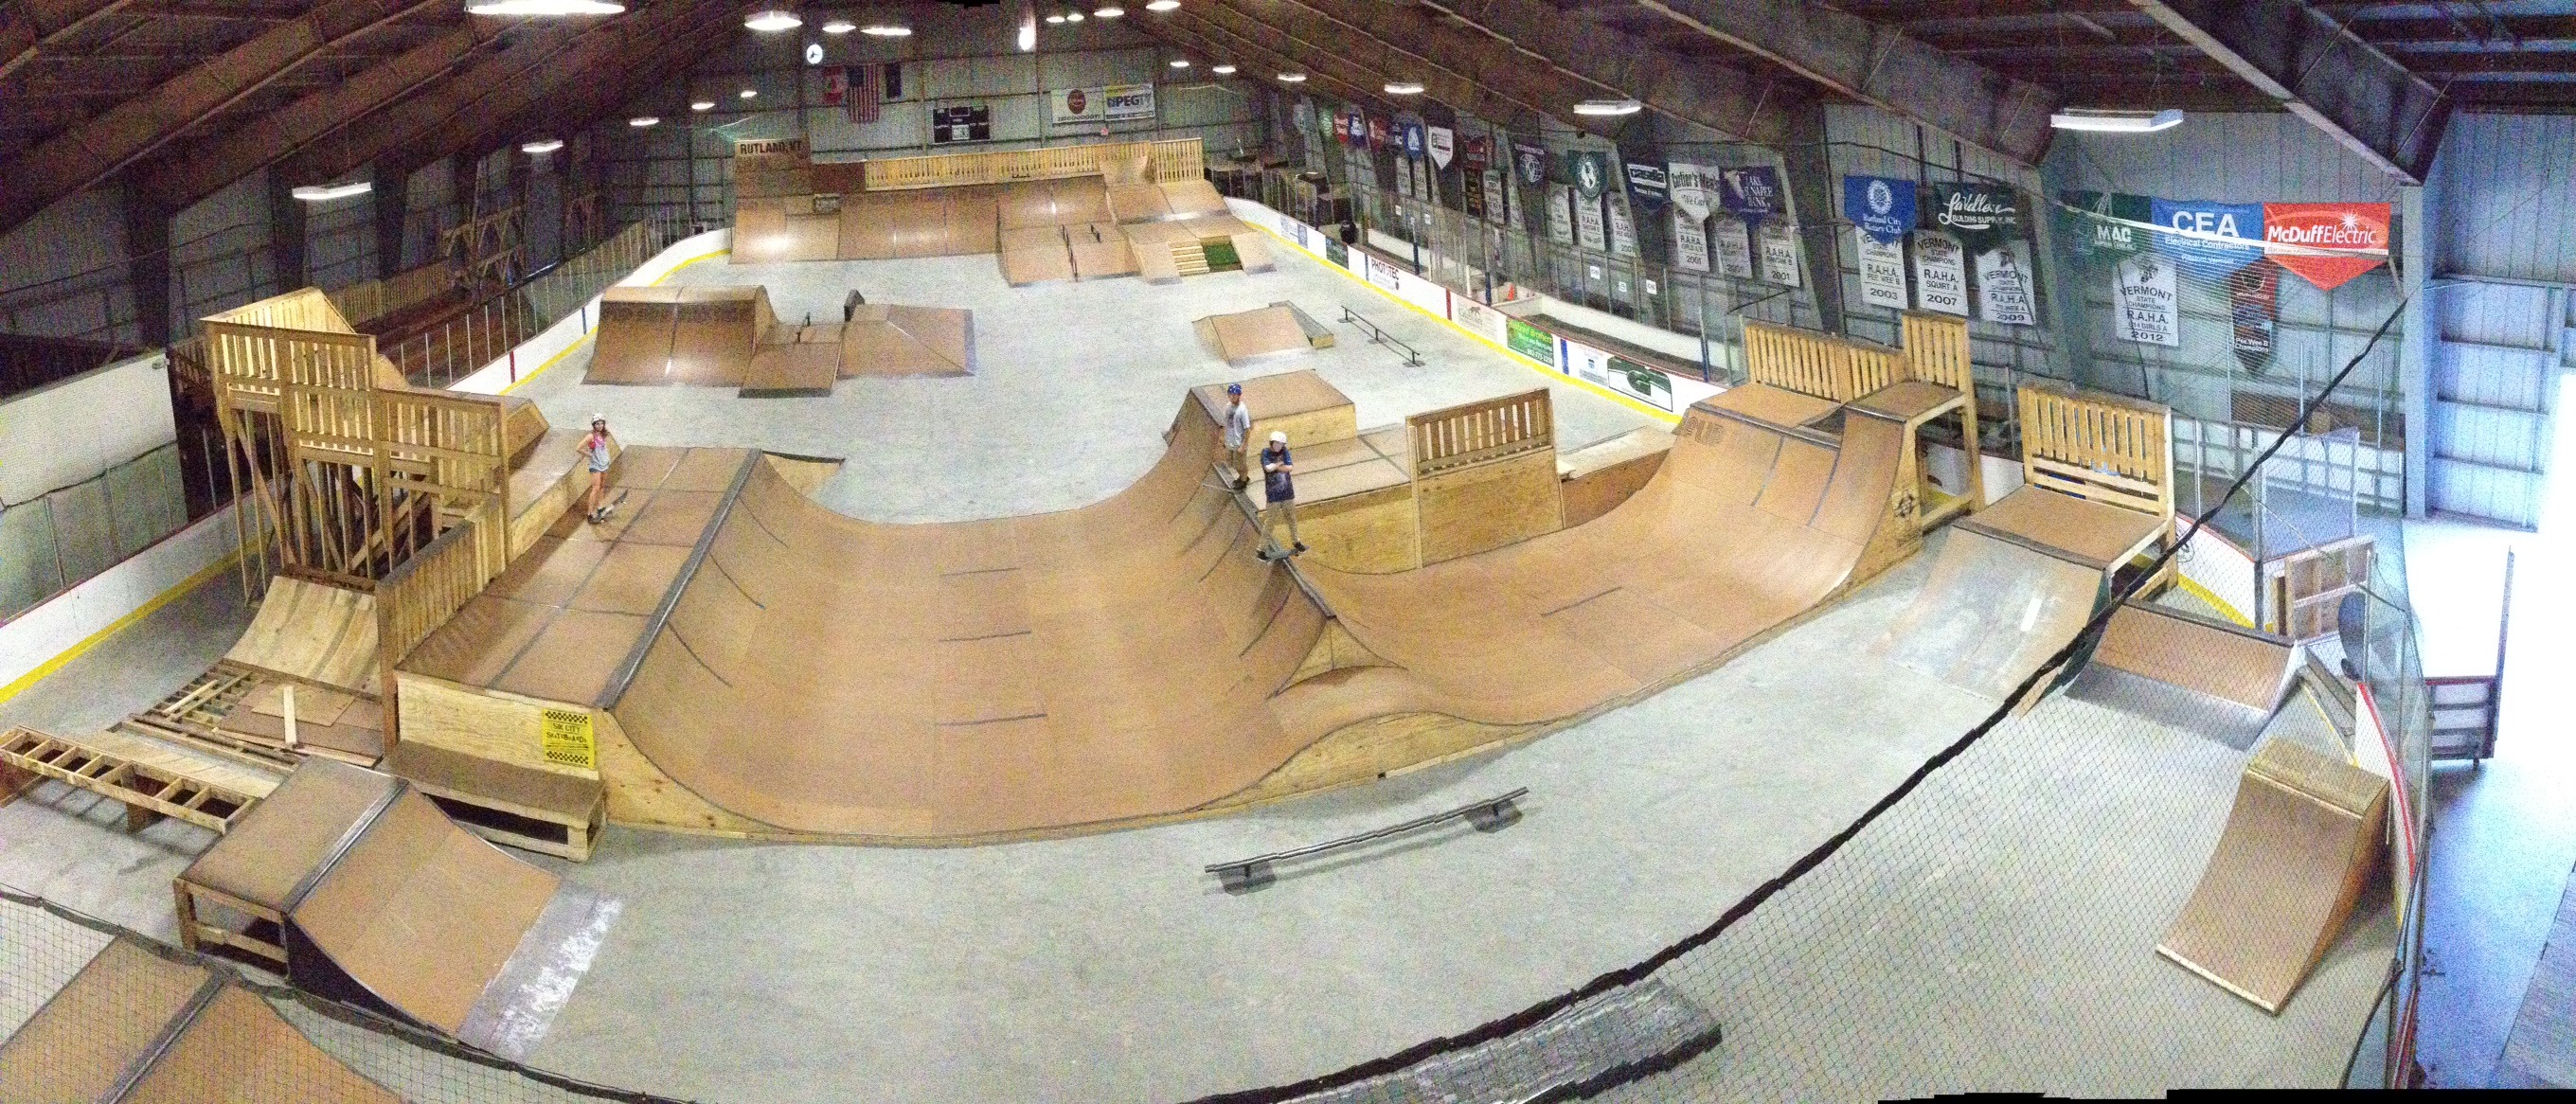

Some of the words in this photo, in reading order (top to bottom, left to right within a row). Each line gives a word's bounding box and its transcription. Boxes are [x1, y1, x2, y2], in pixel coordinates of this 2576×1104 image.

[1887, 216, 1902, 227] City
[2173, 211, 2241, 239] CEA
[2096, 224, 2131, 242] MAC
[1917, 238, 1959, 255] VERMONT
[1923, 269, 1959, 283] R.A.H.A.
[1926, 280, 1950, 291] SQUIRT
[1869, 288, 1898, 300] 2003
[1926, 294, 1958, 306] 2007
[2120, 286, 2173, 302] VERMONT
[2128, 301, 2166, 312] CHAMPIONS
[2127, 311, 2169, 325] R.A.H.A.
[2141, 323, 2161, 331] GIRLS
[2131, 331, 2164, 342] 2012
[565, 724, 581, 733] CITY
